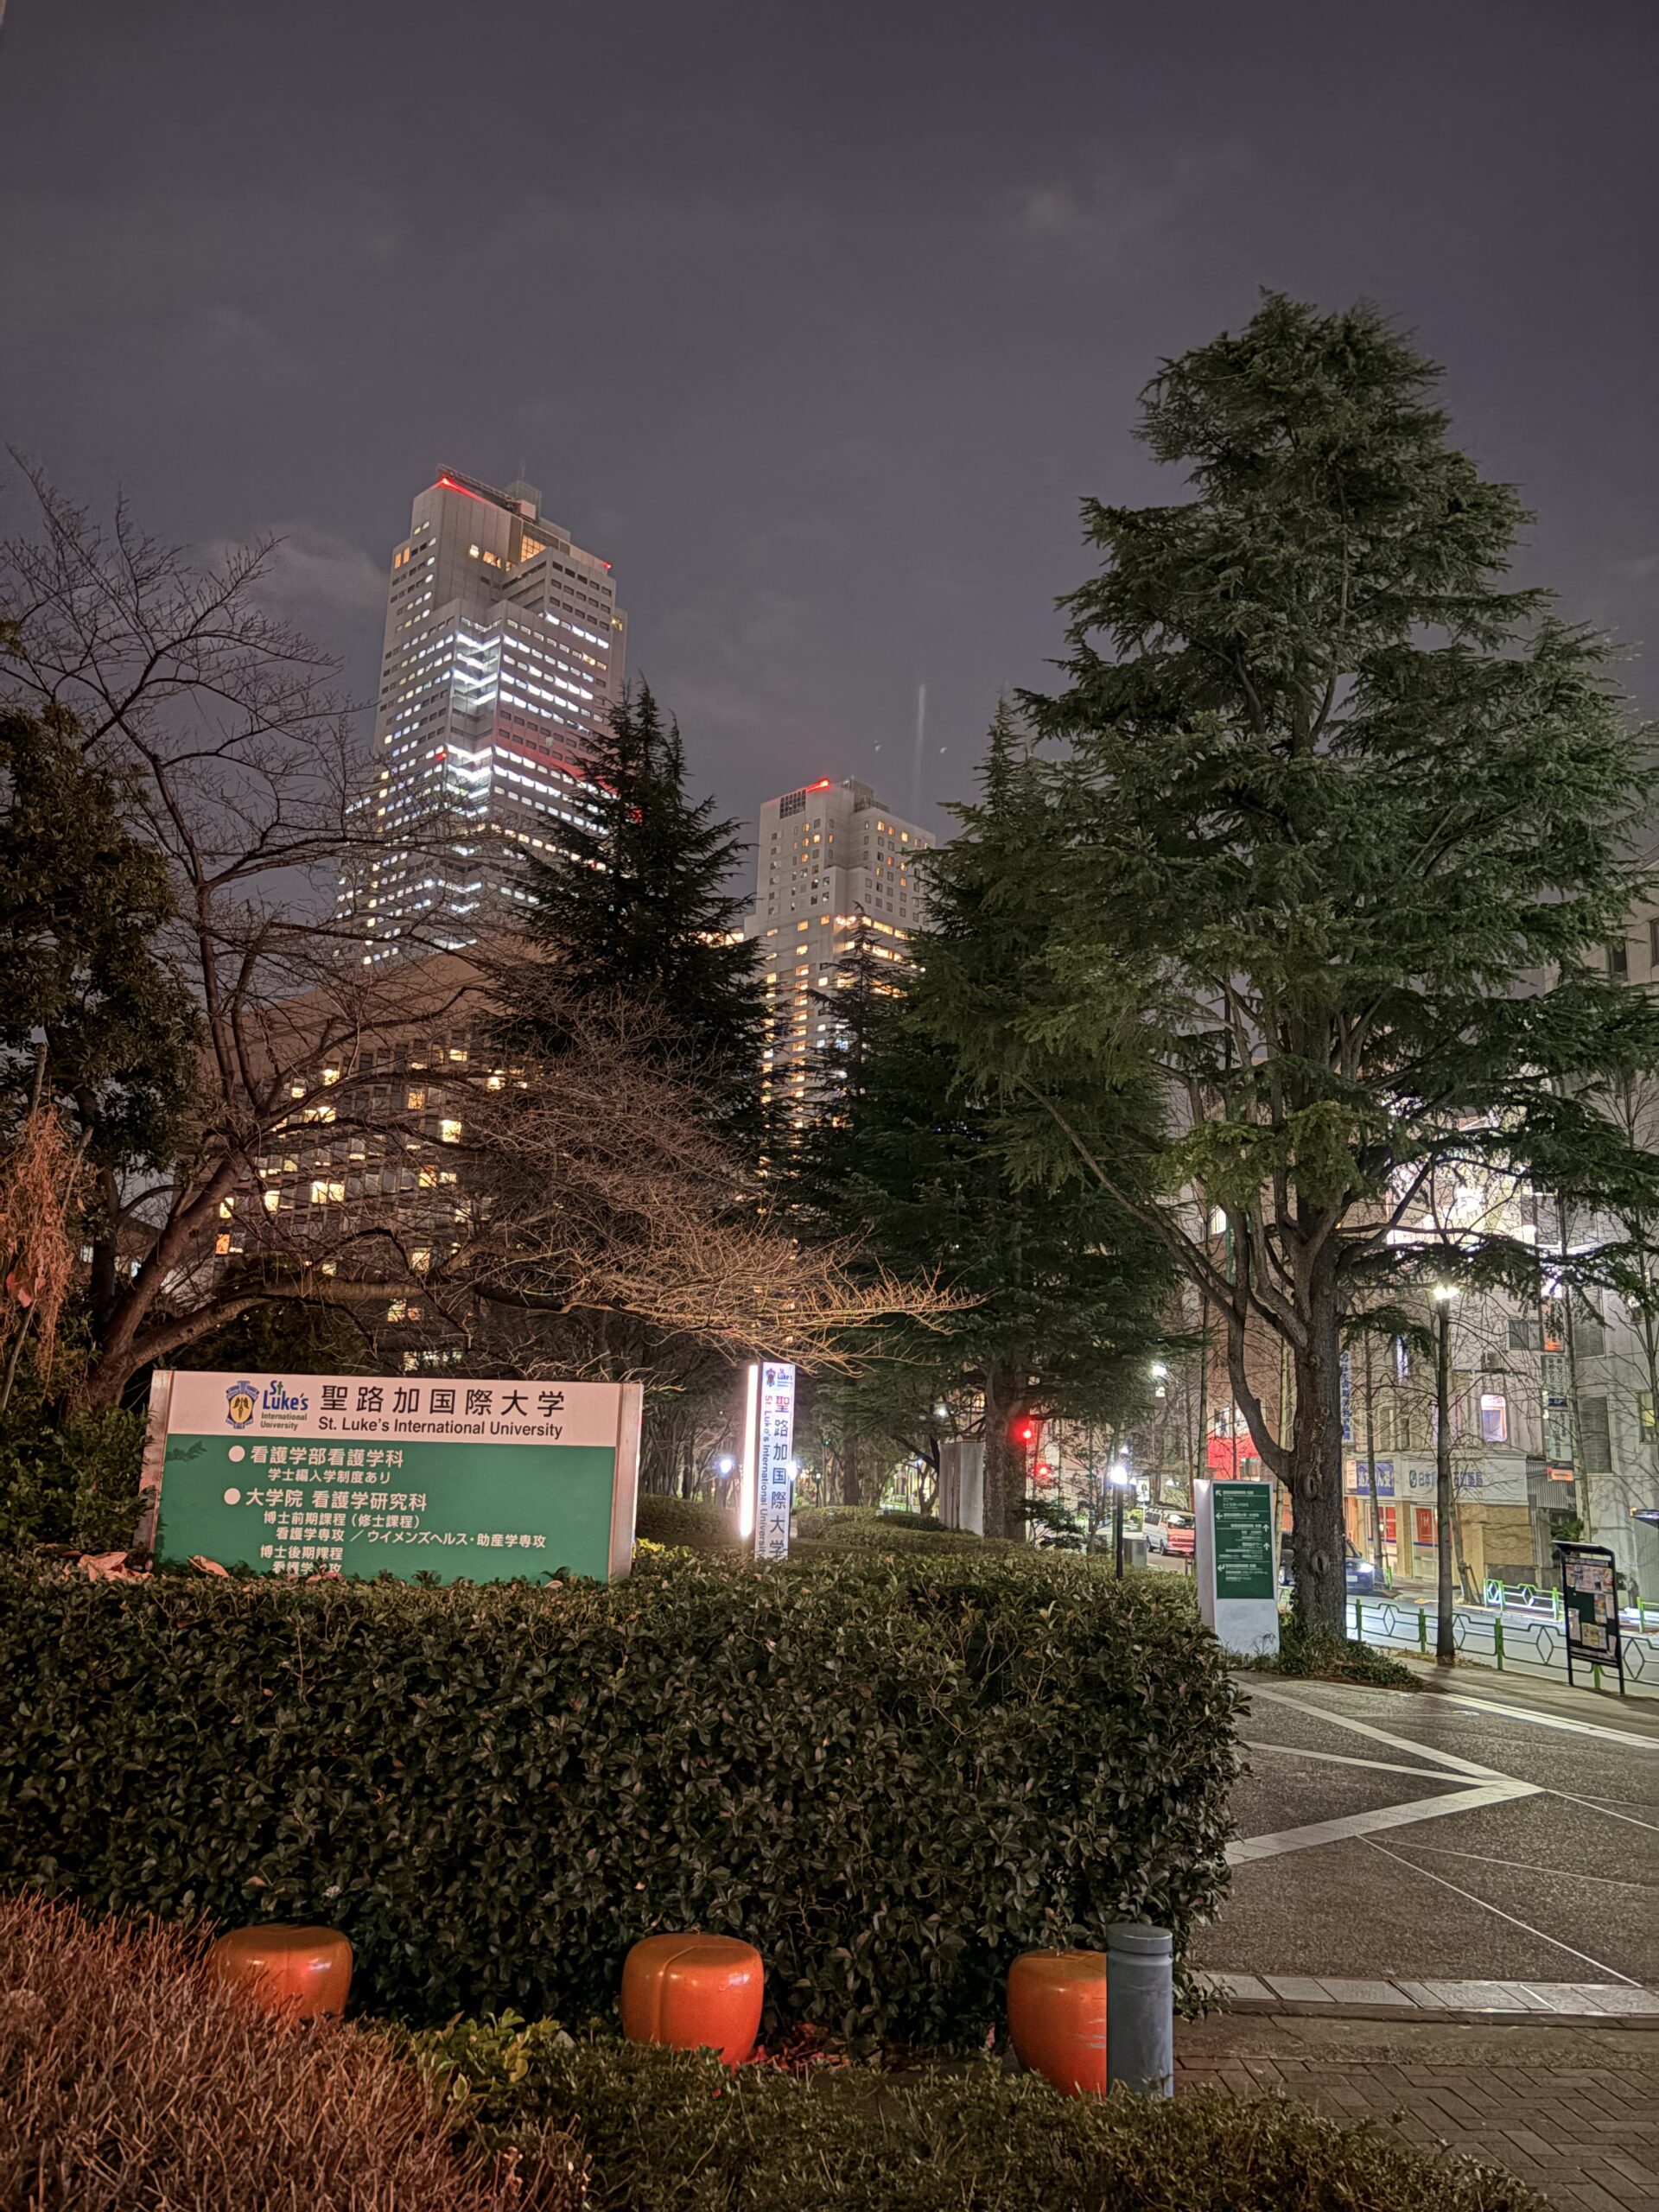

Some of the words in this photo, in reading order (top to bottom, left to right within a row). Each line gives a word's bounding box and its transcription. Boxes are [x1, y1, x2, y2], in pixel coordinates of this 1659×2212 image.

[270, 1380, 283, 1395] St
[263, 1389, 308, 1410] Luke's
[319, 1384, 565, 1418] 聖路加国際大学
[260, 1421, 298, 1432] University
[262, 1411, 308, 1421] International
[318, 1416, 337, 1430] St.
[342, 1418, 390, 1433] Luke's
[394, 1419, 484, 1435] International
[490, 1421, 563, 1440] University
[251, 1445, 404, 1468] 看護学部看護学科
[268, 1468, 391, 1484] 学士編入学制度あり
[760, 1445, 771, 1505] International
[769, 1395, 790, 1559] 聖路加国際大学
[245, 1487, 303, 1509] 大学院
[312, 1490, 427, 1512] 看護学研究科
[260, 1544, 344, 1560] 博士後期課程
